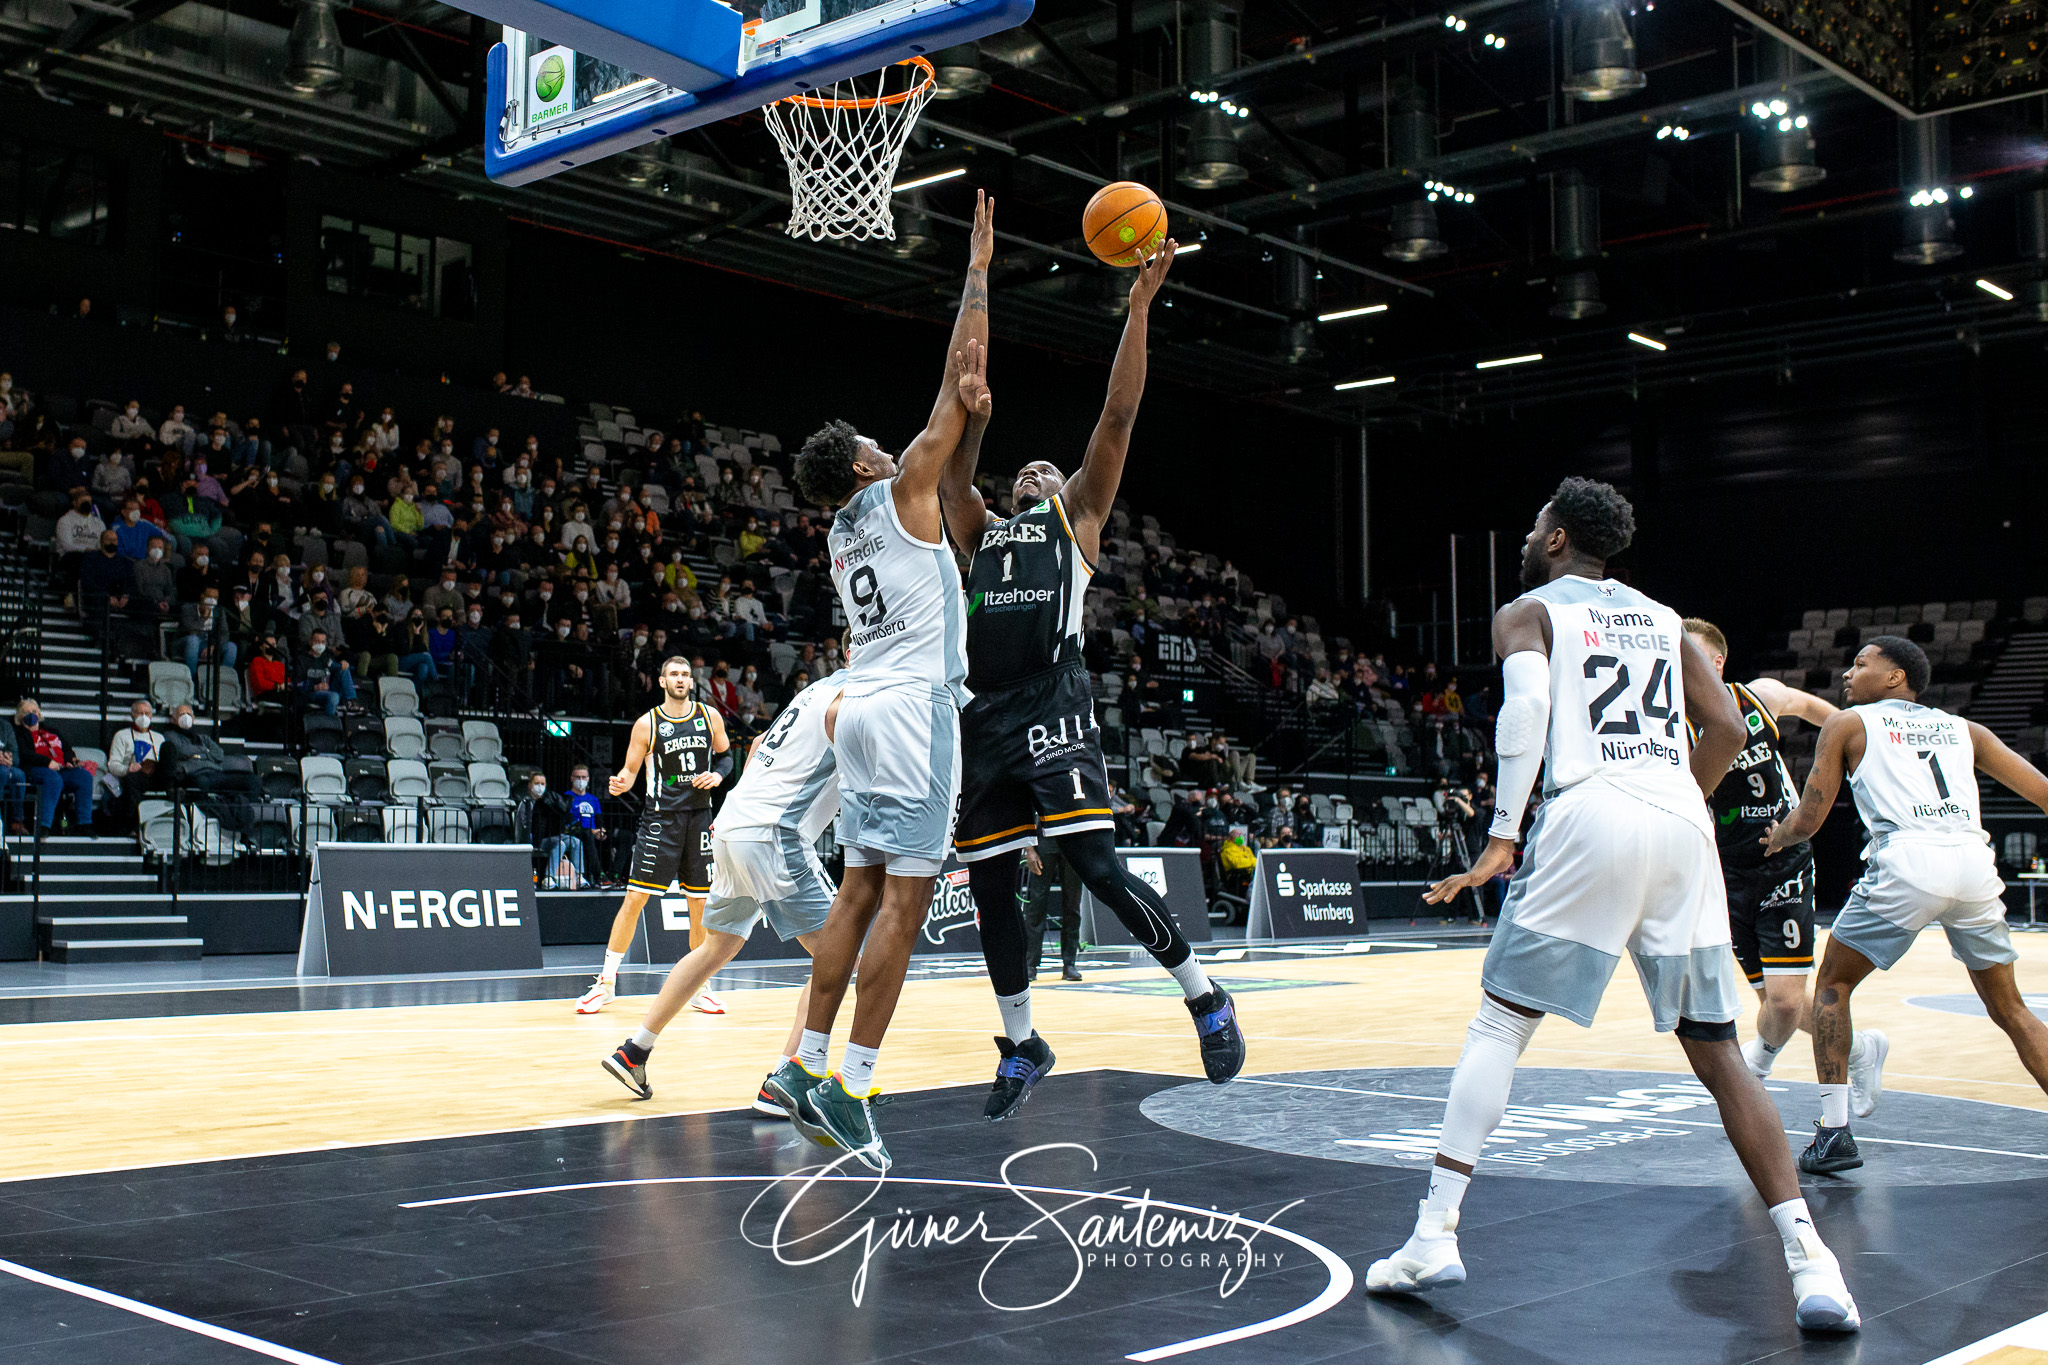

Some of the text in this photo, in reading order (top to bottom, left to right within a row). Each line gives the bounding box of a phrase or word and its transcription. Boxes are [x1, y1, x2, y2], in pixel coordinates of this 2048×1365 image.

[531, 102, 568, 123] BARMER
[1001, 551, 1013, 583] 1
[849, 564, 888, 628] 9
[983, 587, 1055, 606] Itzehoer
[984, 603, 1037, 614] Versicherungen
[1588, 607, 1654, 629] Nyama
[1582, 654, 1680, 739] 24
[663, 735, 708, 755] EAGLES
[1045, 749, 1064, 761] SIND
[1064, 742, 1086, 754] MODE
[678, 751, 697, 772] 13
[1069, 767, 1086, 800] 1
[1747, 772, 1766, 798] 9
[1917, 750, 1951, 801] 1
[1298, 878, 1353, 900] Sparkasse
[1302, 902, 1355, 924] Nürnberg
[1782, 918, 1801, 949] 9
[1478, 1126, 1693, 1167] Personal
